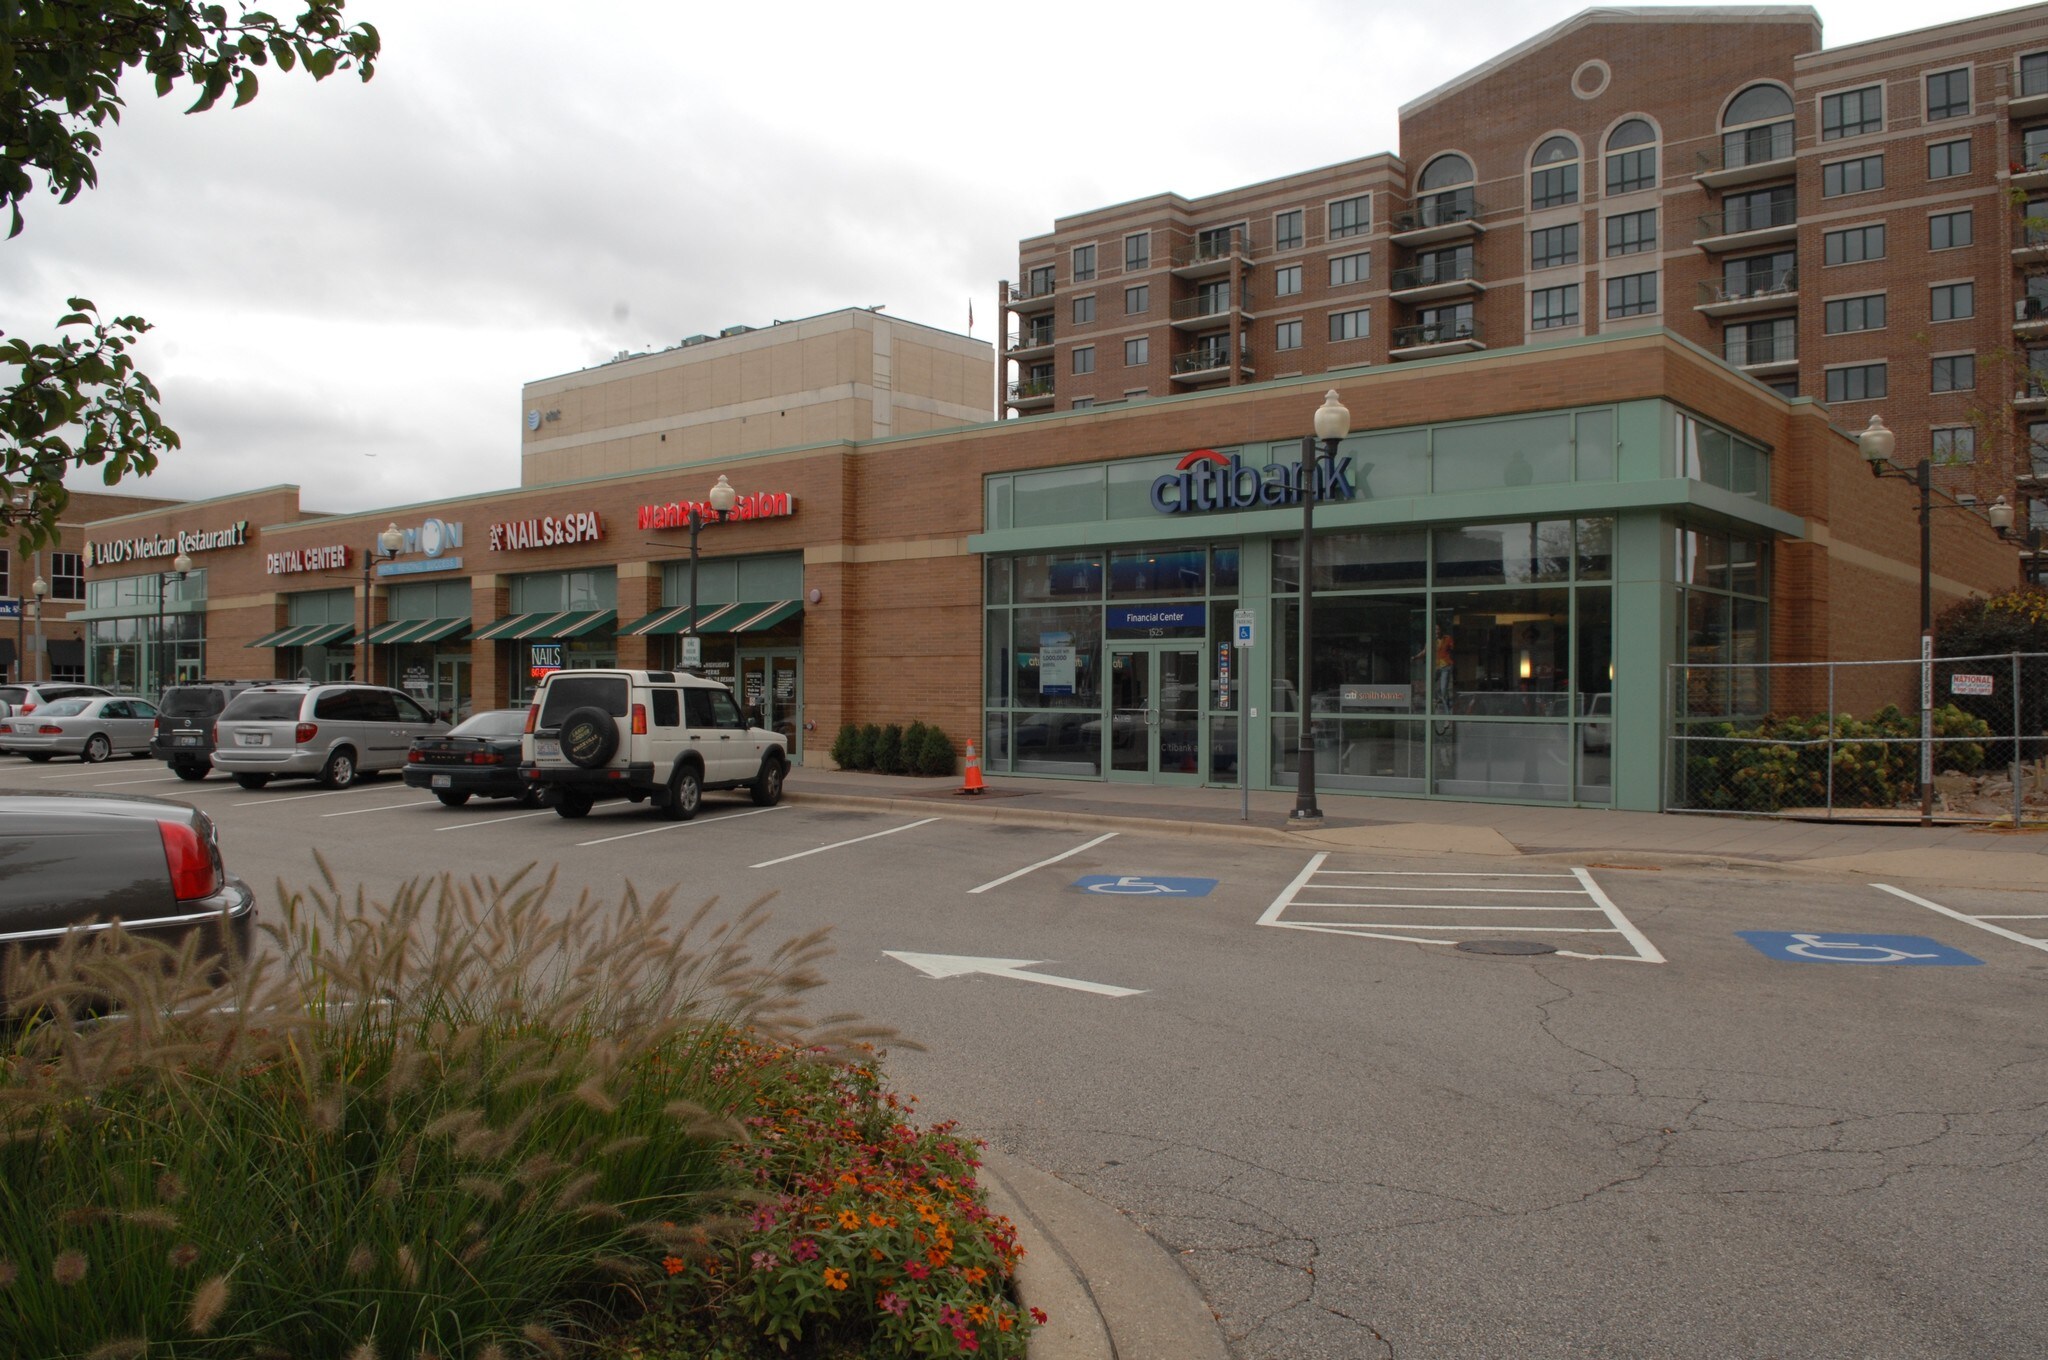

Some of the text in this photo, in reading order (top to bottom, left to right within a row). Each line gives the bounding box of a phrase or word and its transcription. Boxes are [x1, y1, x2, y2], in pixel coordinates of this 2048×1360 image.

[1151, 453, 1355, 513] citibank
[377, 517, 464, 557] KMON
[506, 512, 599, 549] NAILS&SPA
[97, 523, 238, 564] LALO'S Mexican Restaurant
[267, 544, 346, 574] DENTAL CENTER
[1127, 612, 1184, 622] Financial Center
[1149, 628, 1163, 636] 1525
[532, 647, 561, 665] NAILS
[1953, 675, 1991, 683] NATIONAL
[1161, 744, 1192, 752] Ctibank
